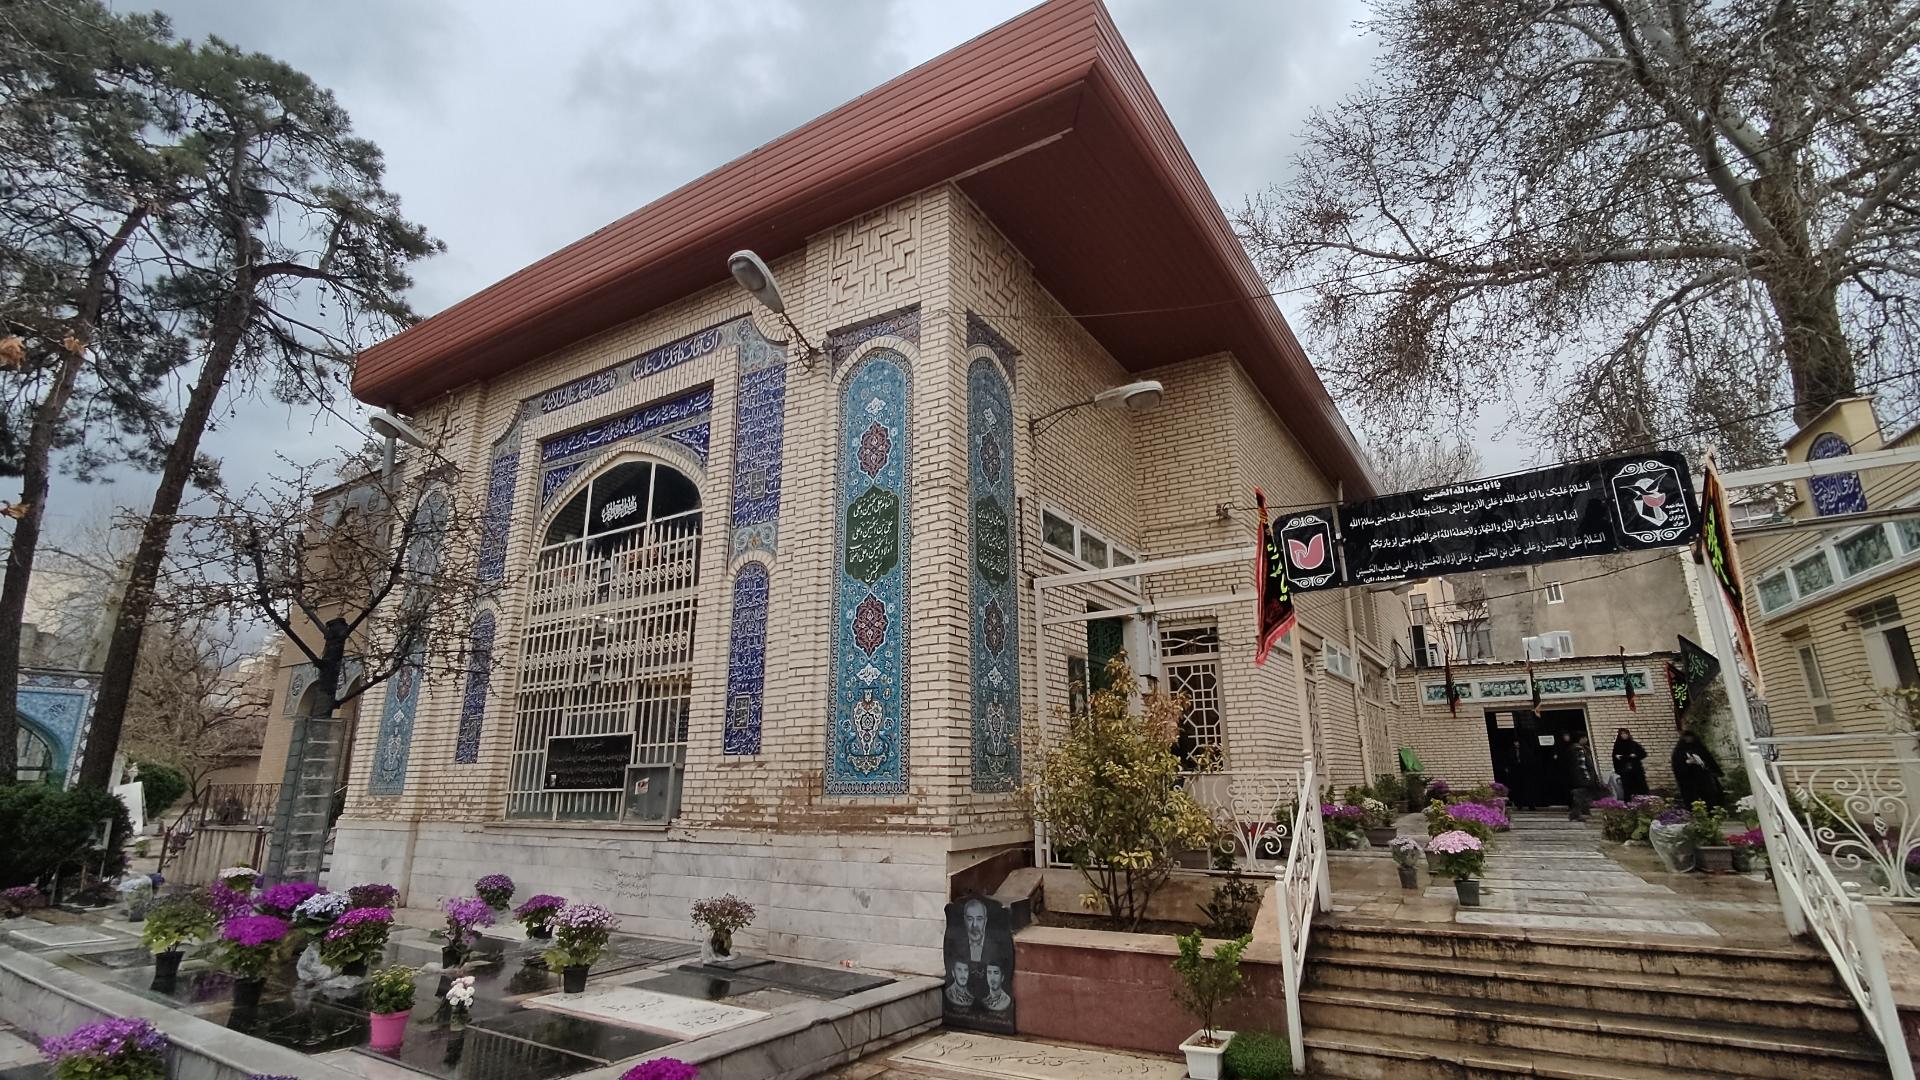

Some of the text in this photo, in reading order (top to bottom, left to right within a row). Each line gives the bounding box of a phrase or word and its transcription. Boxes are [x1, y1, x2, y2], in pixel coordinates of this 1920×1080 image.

[1422, 488, 1453, 501] الحسین
[1538, 490, 1545, 499] یا
[1545, 487, 1568, 498] علیک
[1387, 512, 1406, 521] علیک
[1349, 519, 1361, 528] الله
[1361, 518, 1374, 529] سلام
[1541, 538, 1568, 554] الحسین
[1474, 548, 1499, 562] الحسین
[1418, 556, 1442, 570] الحسین
[1356, 564, 1378, 579] الحسین
